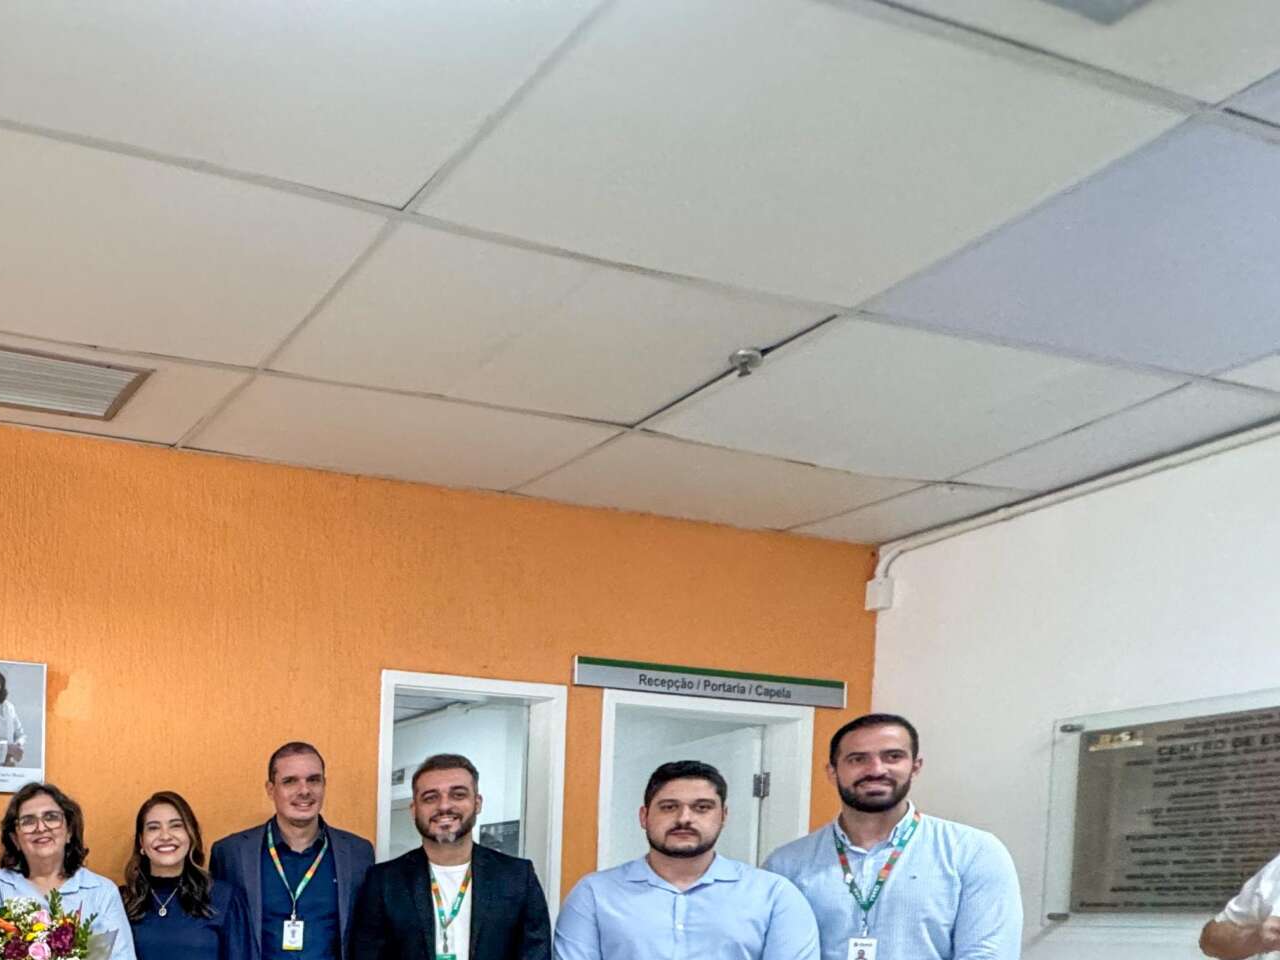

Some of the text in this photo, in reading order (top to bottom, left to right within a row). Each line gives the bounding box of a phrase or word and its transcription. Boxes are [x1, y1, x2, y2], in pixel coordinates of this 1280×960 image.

[638, 673, 694, 692] Recepção
[703, 679, 747, 695] Portaria
[755, 684, 793, 699] Capela
